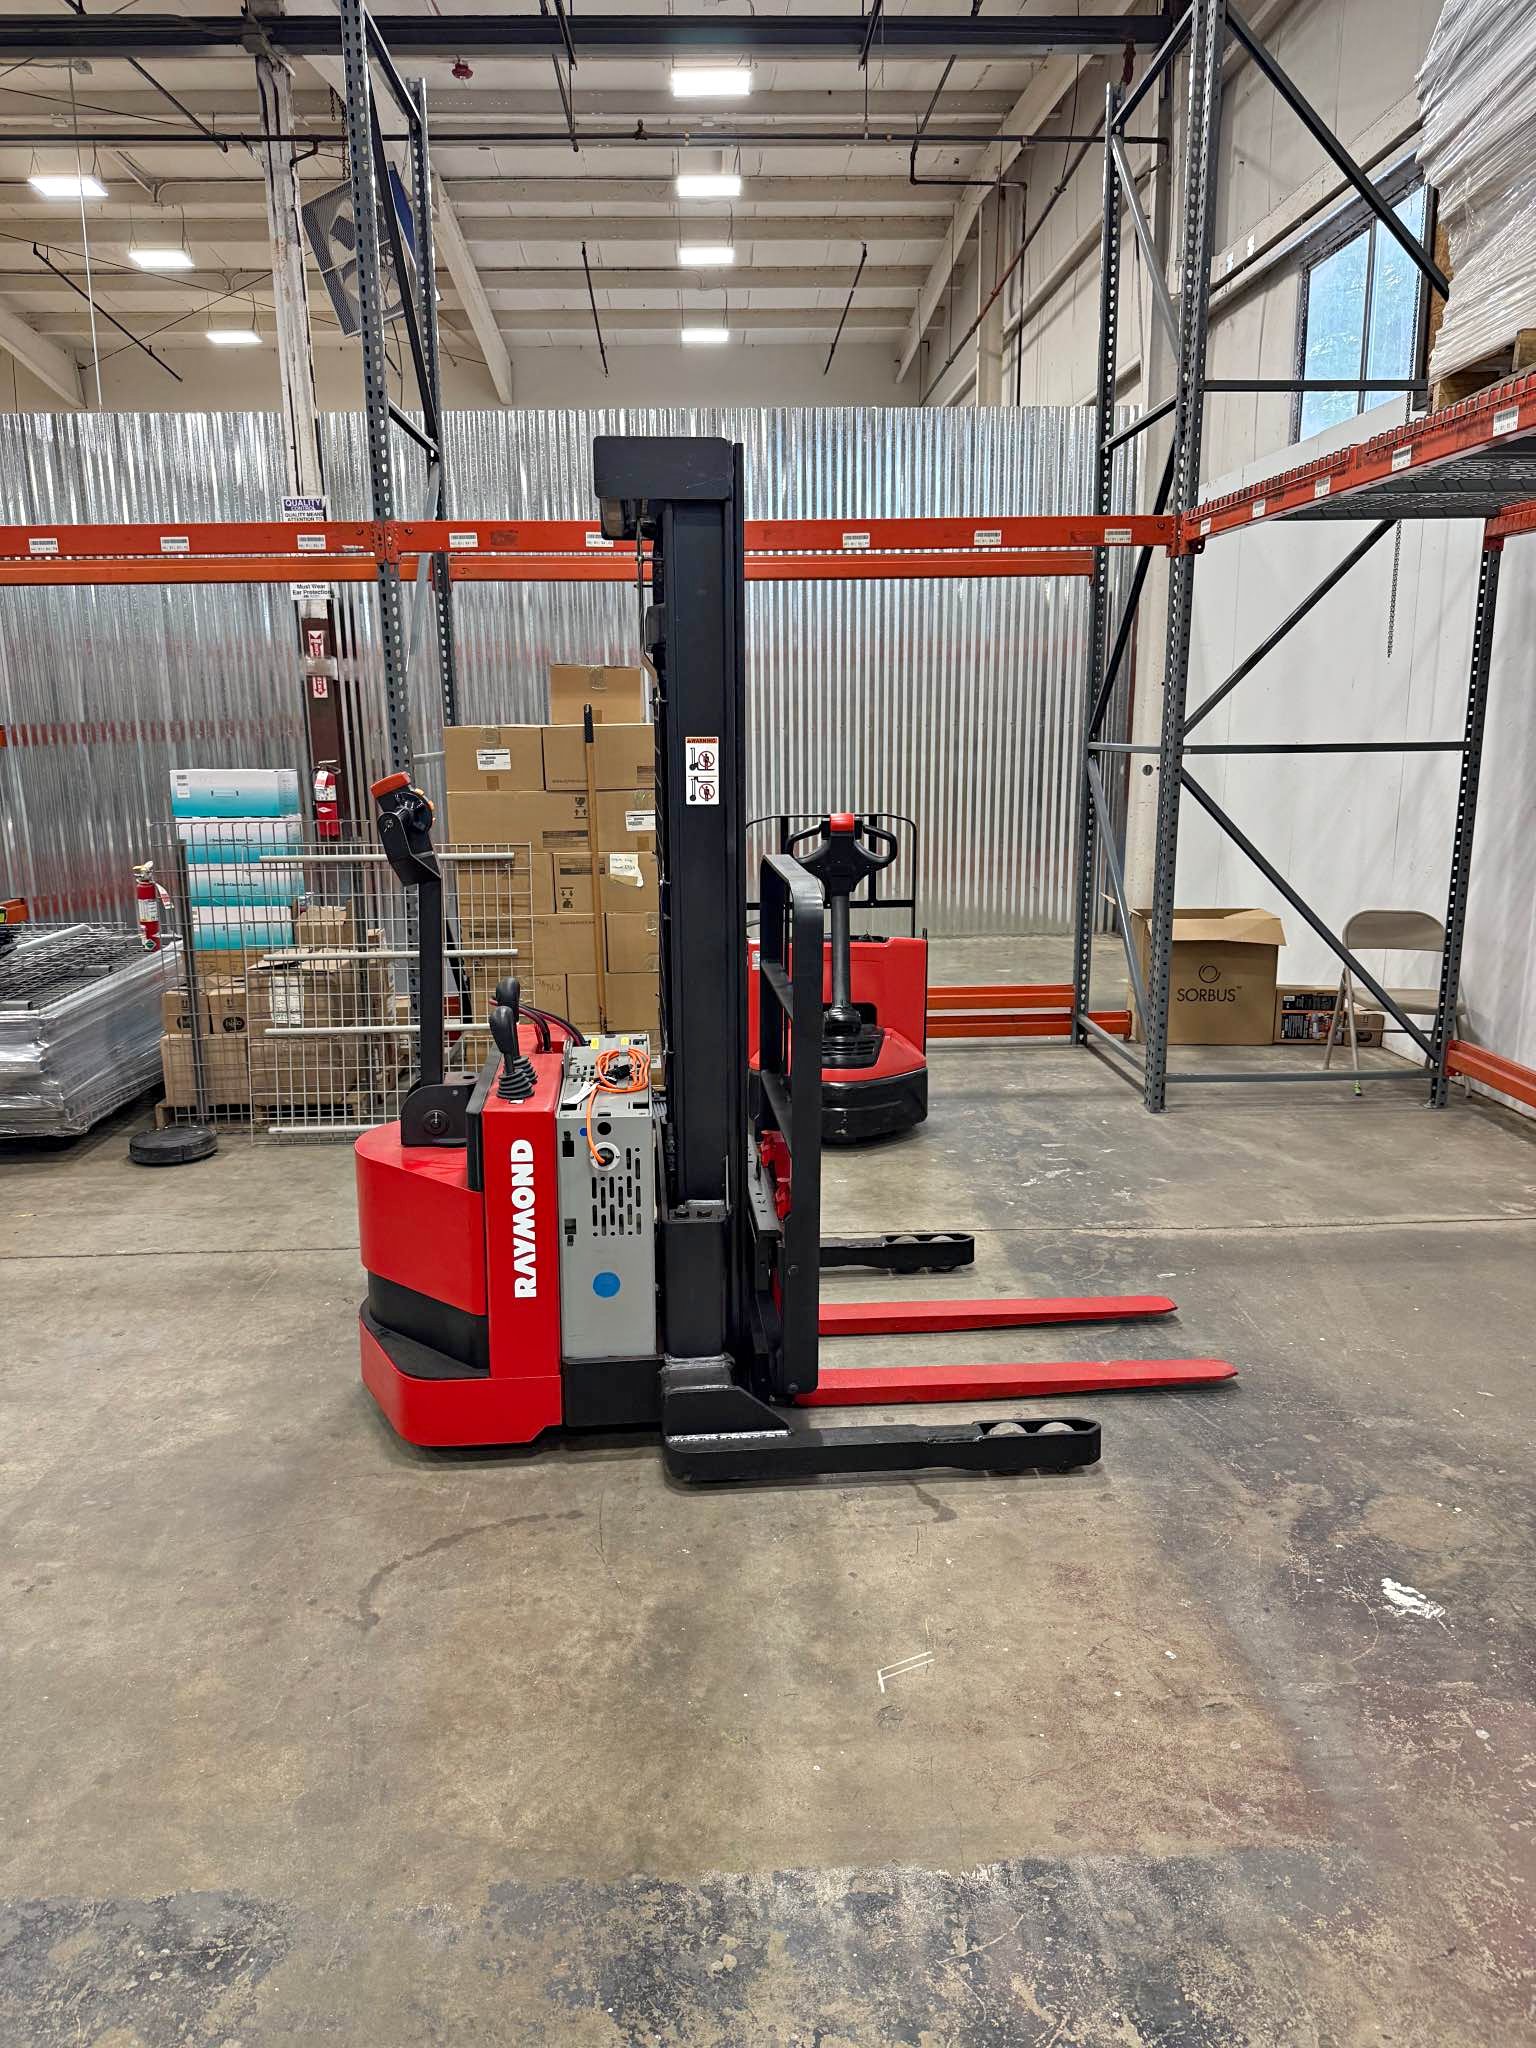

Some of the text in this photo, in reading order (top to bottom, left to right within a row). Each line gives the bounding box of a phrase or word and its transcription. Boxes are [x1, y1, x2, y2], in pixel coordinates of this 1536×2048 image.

[285, 499, 320, 507] QUALITY
[1176, 988, 1236, 1002] SORBUS
[510, 1139, 537, 1298] RAYMOND
